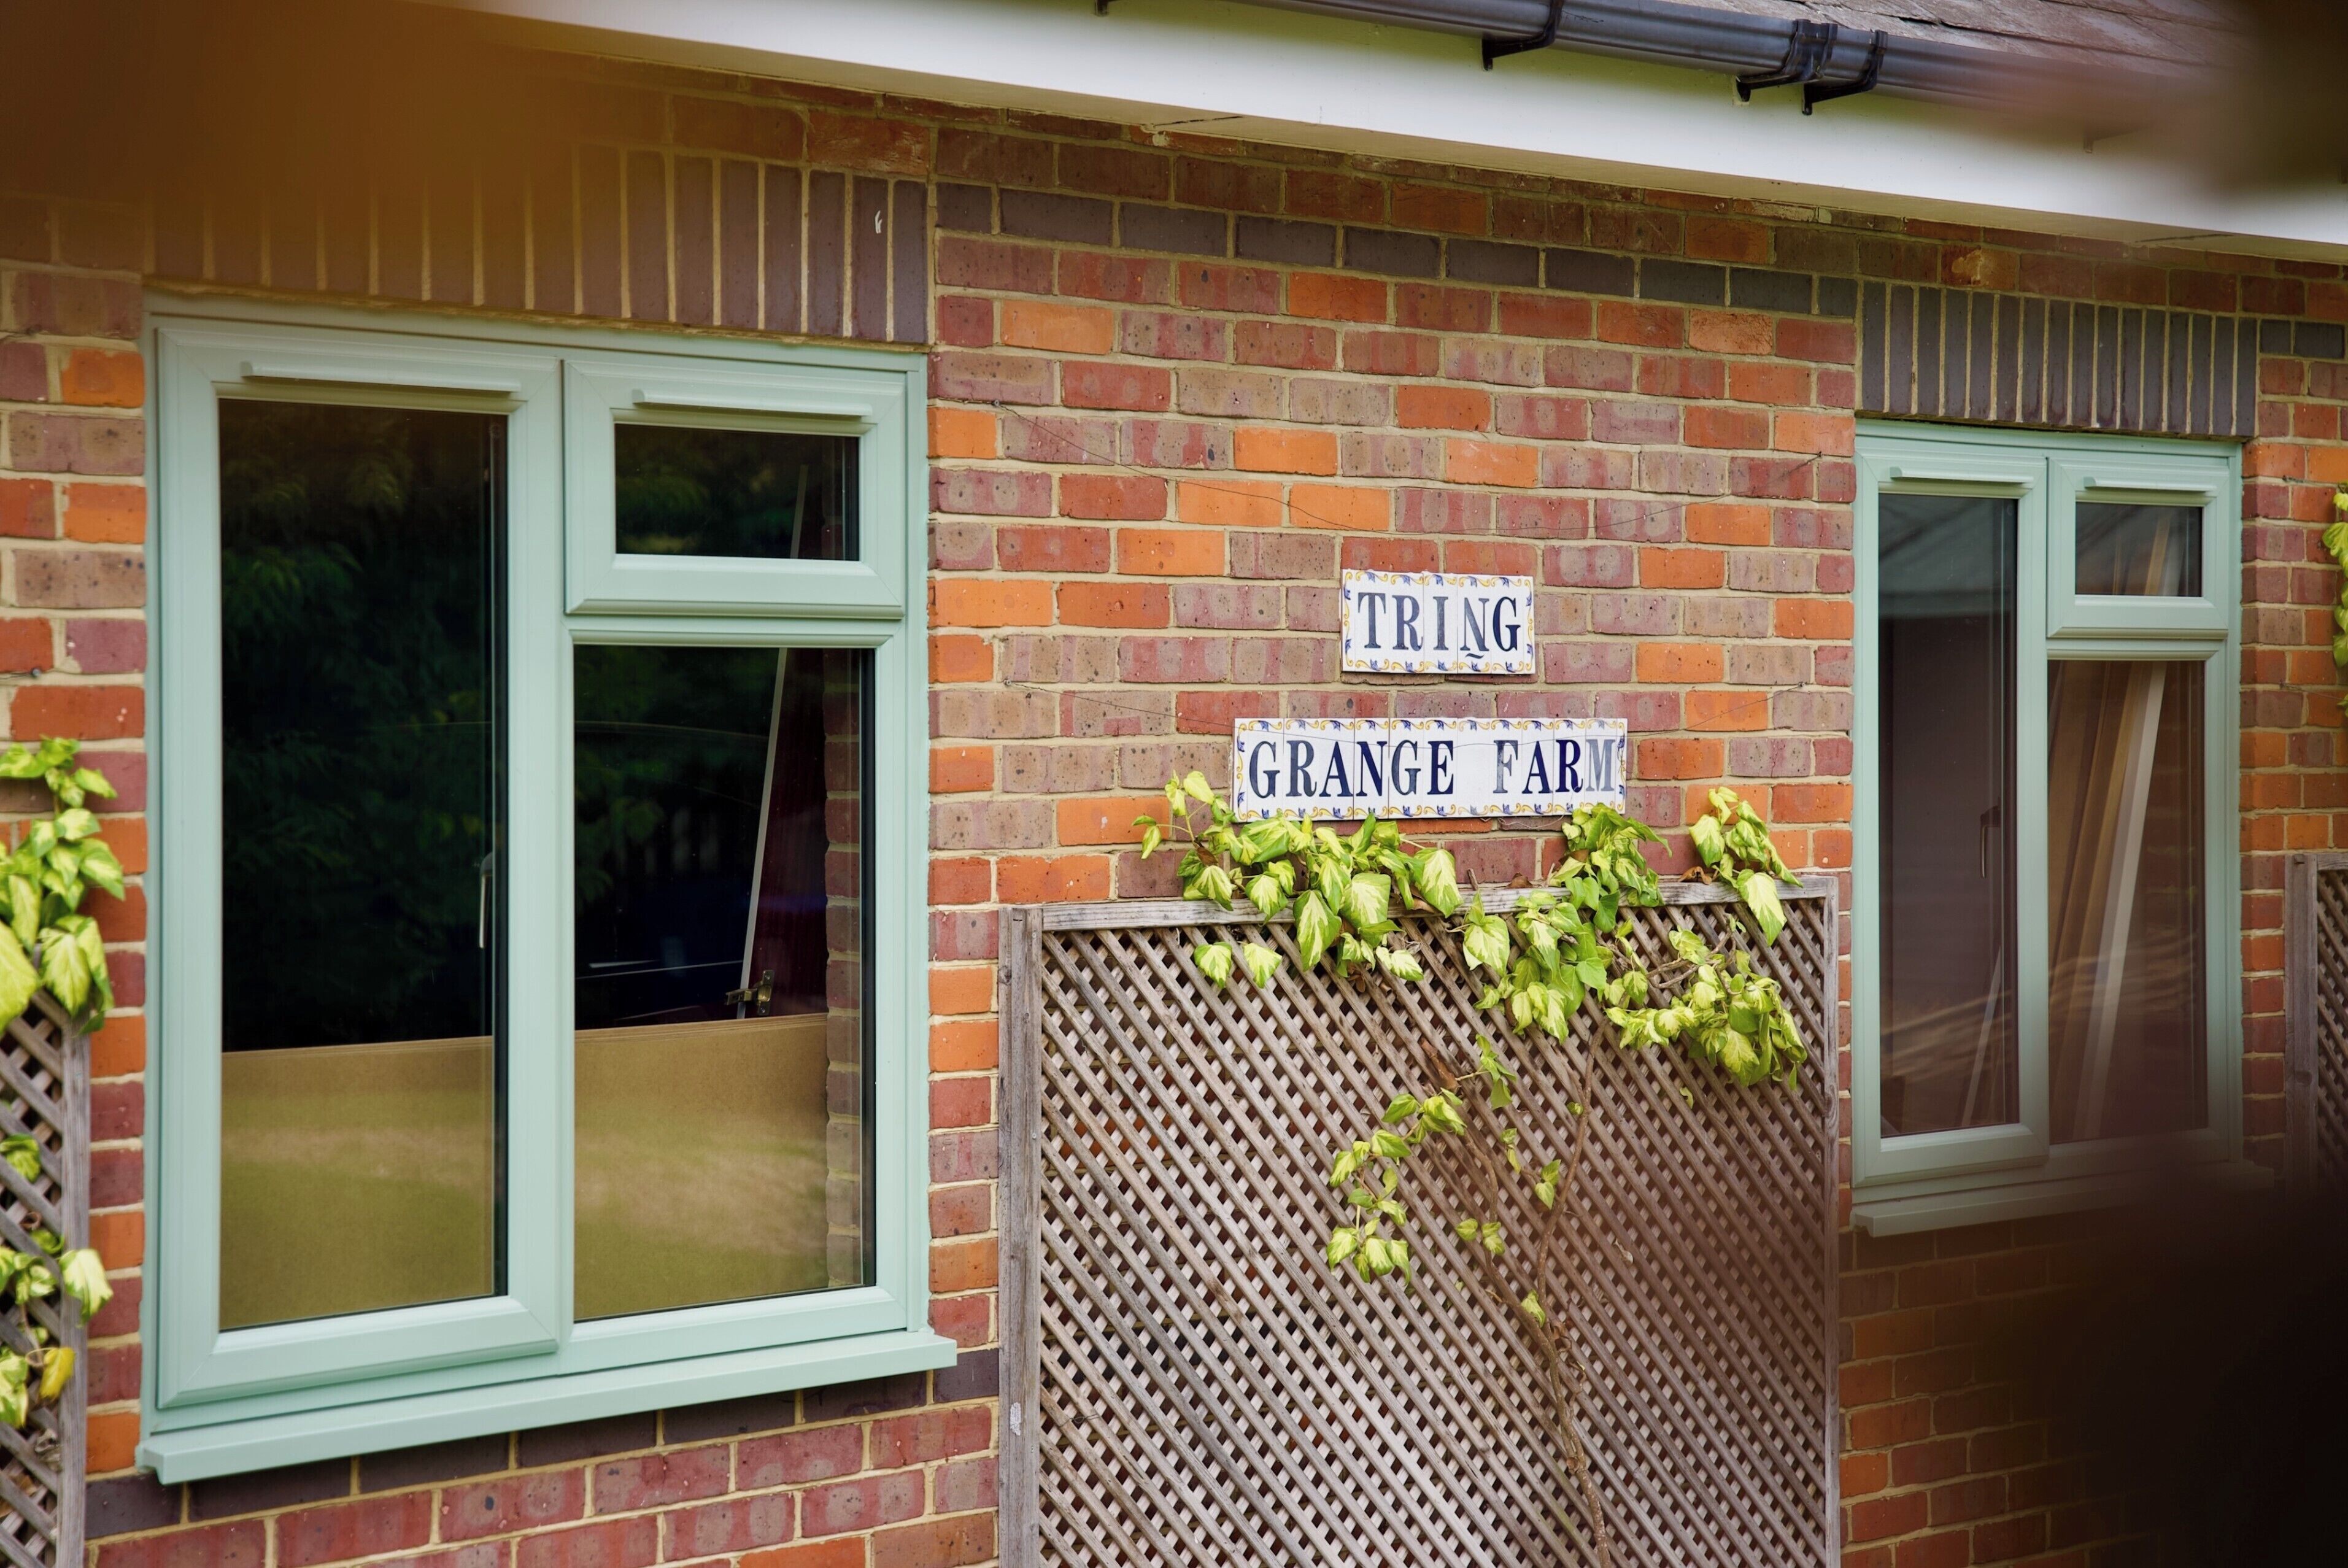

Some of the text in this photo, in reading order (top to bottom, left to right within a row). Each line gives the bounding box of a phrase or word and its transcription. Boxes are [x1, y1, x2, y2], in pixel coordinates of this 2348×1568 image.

[1357, 592, 1521, 654] TRING
[1249, 738, 1615, 798] GRANGE FARM
